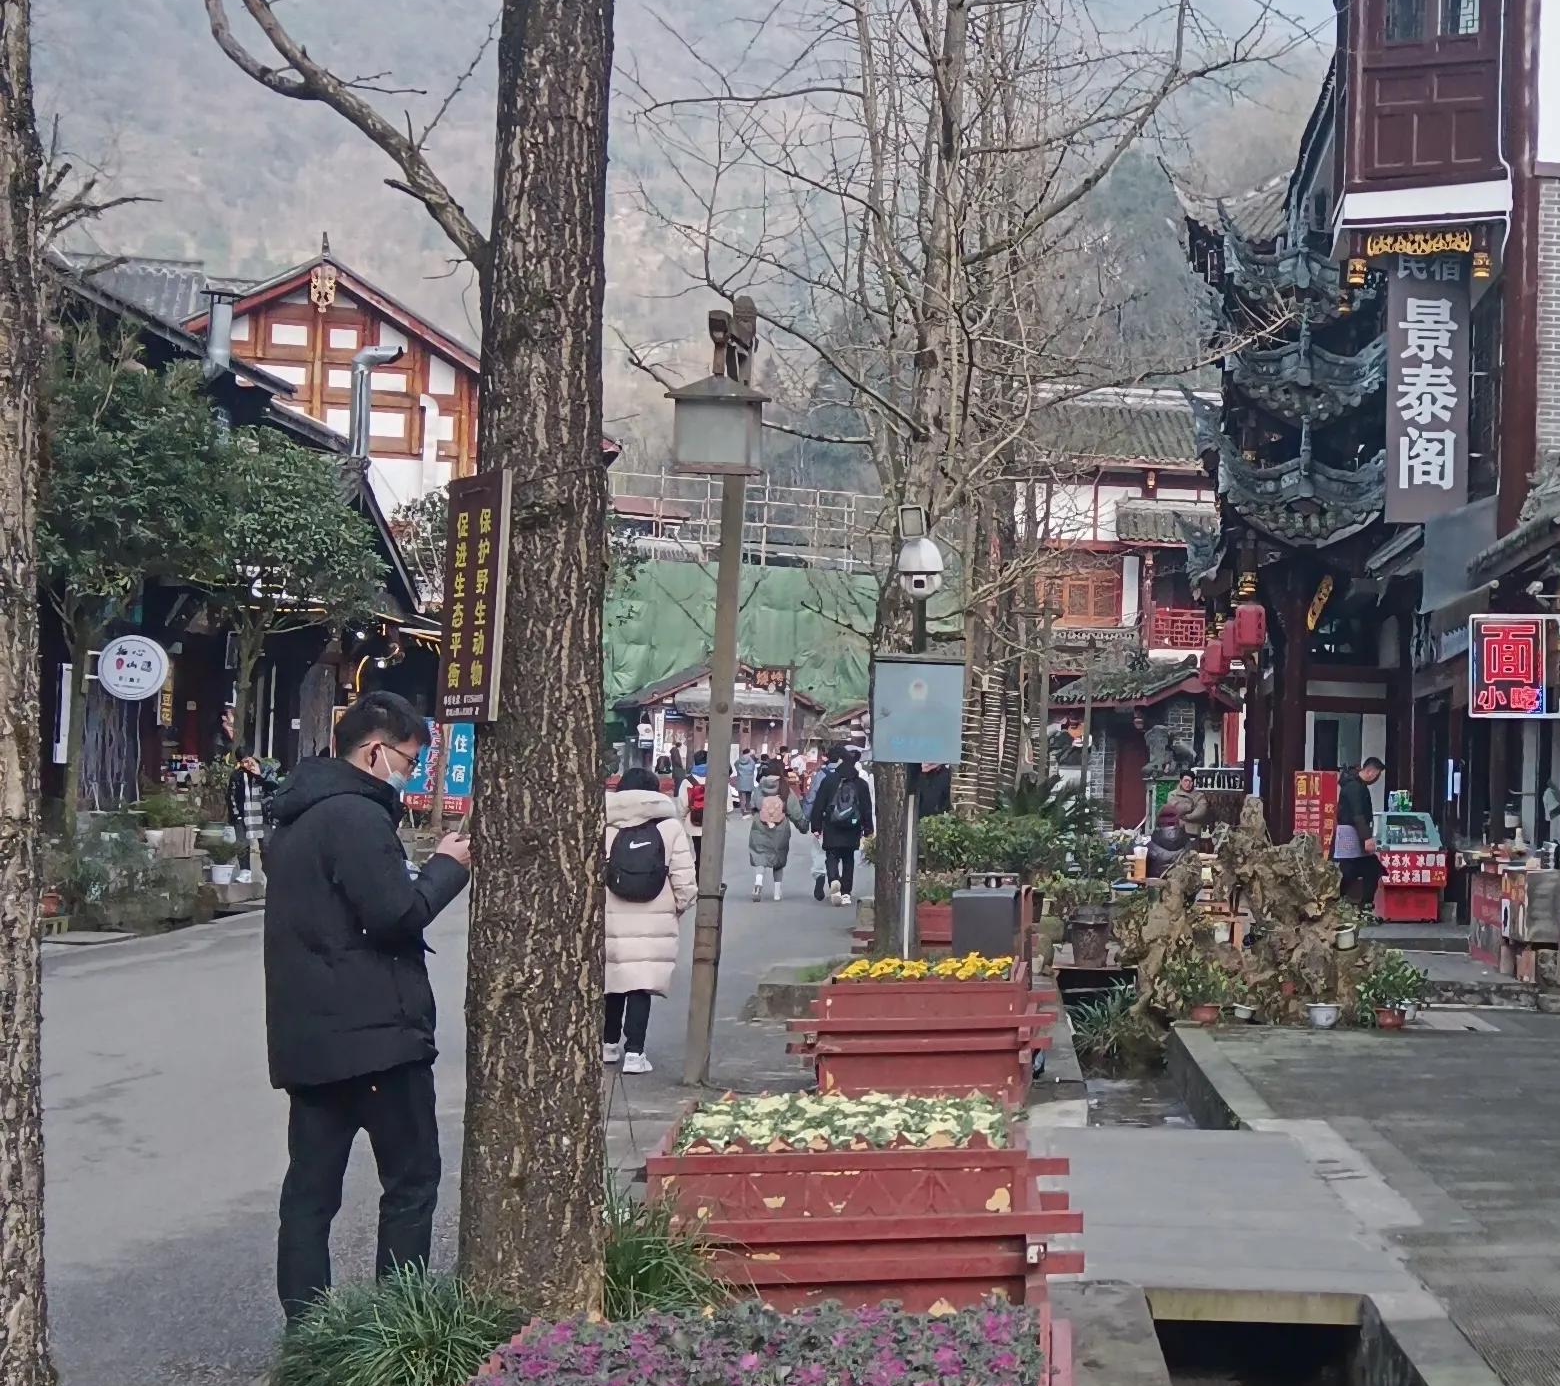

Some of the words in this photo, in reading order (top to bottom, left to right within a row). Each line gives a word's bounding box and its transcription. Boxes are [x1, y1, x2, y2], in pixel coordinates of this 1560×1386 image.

[1397, 255, 1461, 281] 民宿
[1396, 297, 1458, 490] 景泰阁
[447, 512, 469, 689] 促进生态平衡
[470, 508, 492, 688] 保护野生动物
[1482, 625, 1535, 683] 面
[1478, 686, 1541, 710] 小吃
[452, 734, 468, 782] 住宿
